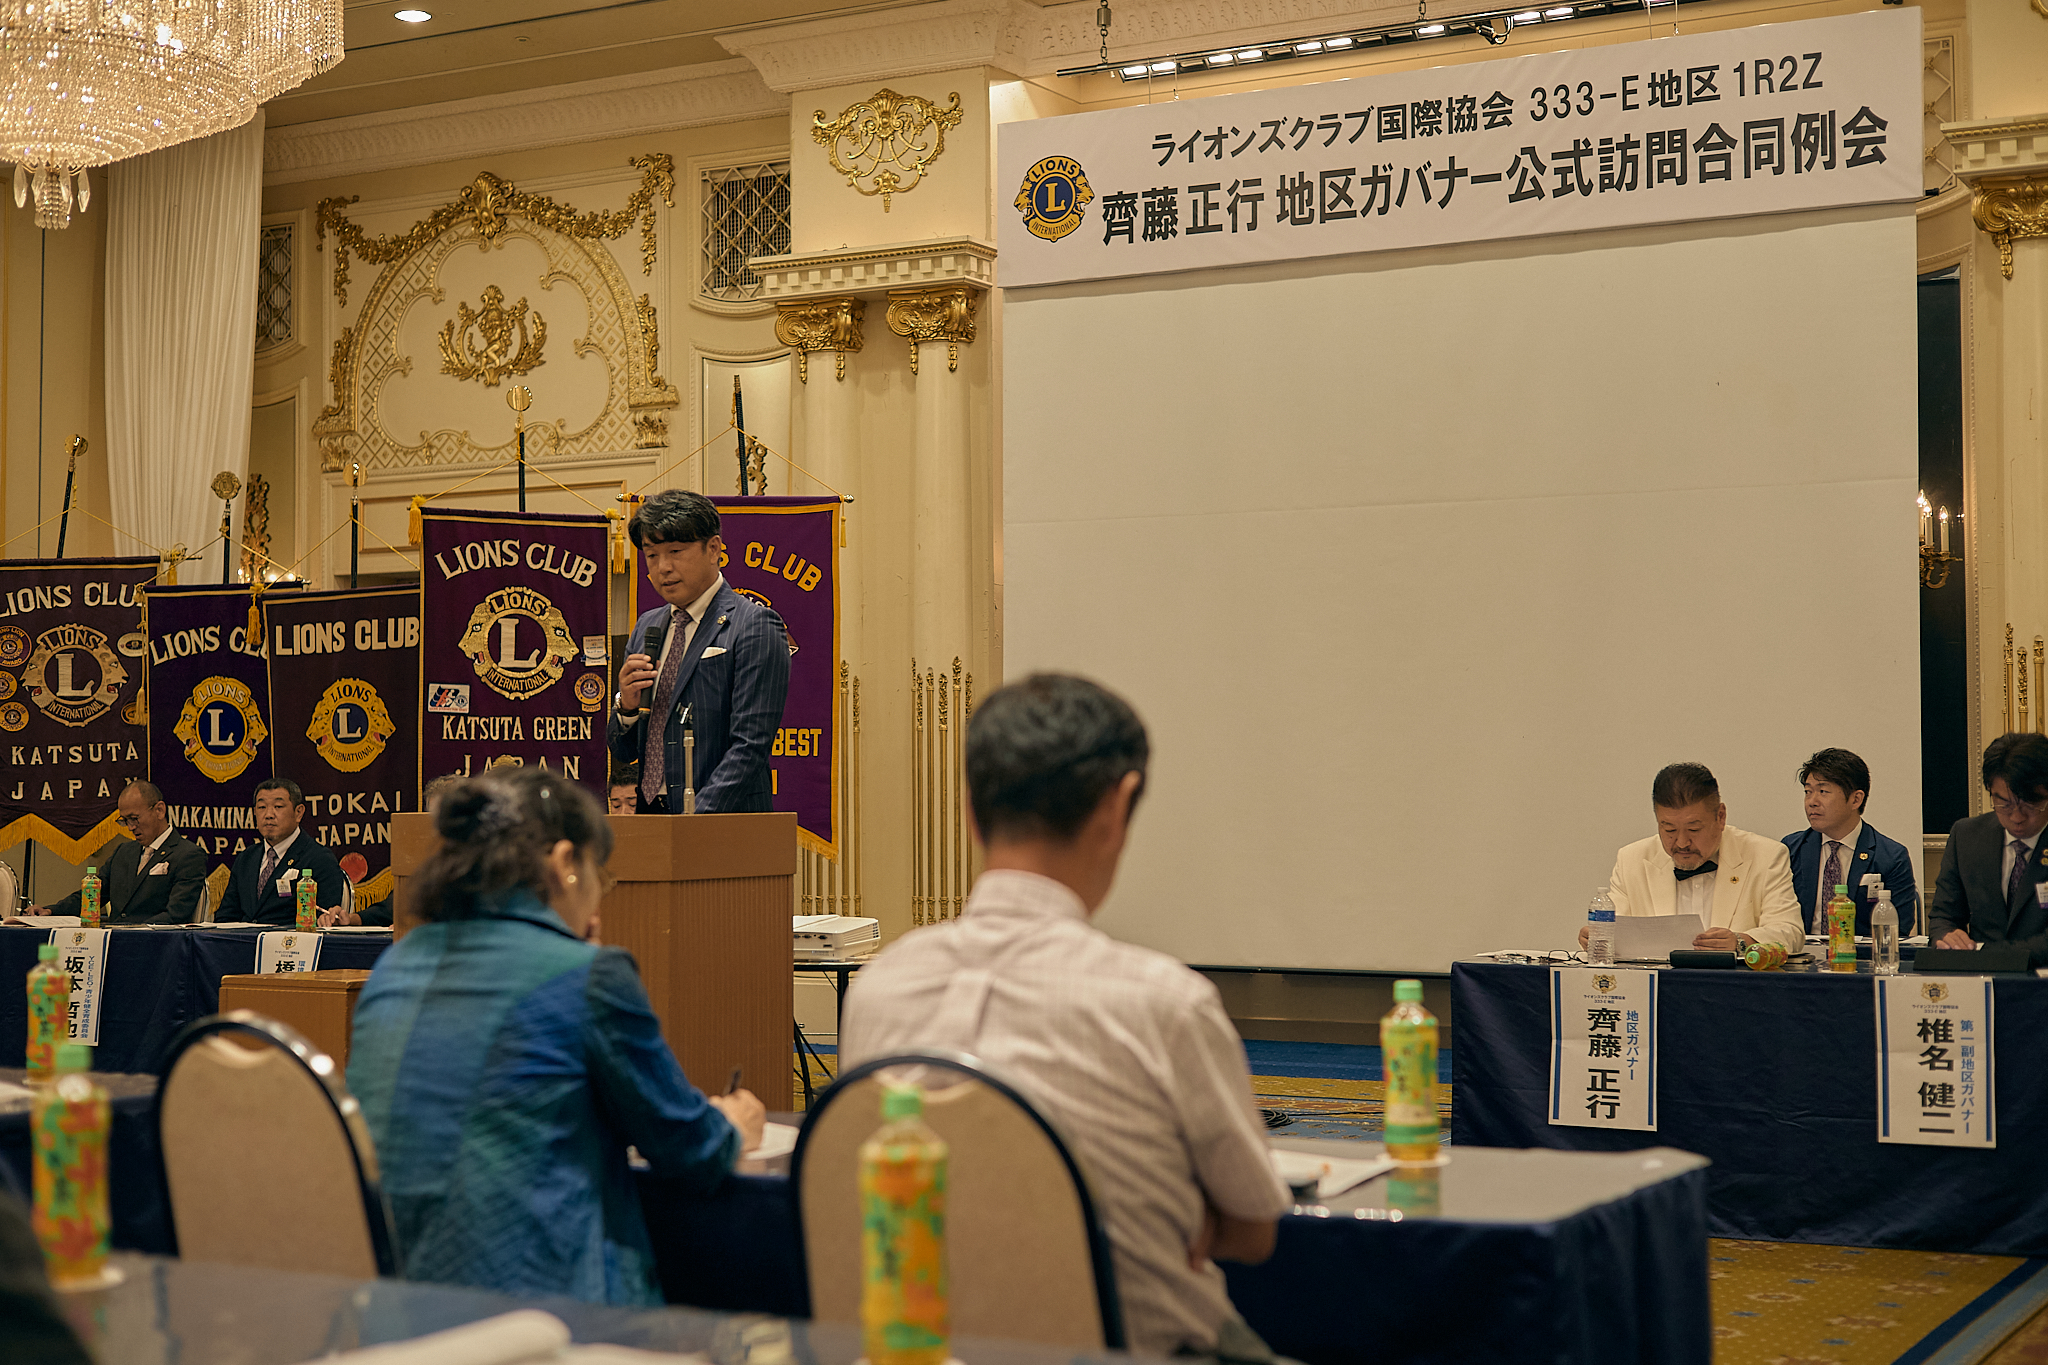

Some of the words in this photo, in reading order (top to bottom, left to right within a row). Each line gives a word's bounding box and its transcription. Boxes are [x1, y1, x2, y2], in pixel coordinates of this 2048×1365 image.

[1152, 91, 1514, 166] ライオンズクラブ国際協会
[1732, 52, 1824, 97] 1R2Z
[1031, 160, 1077, 179] LIONS
[1045, 183, 1066, 212] L
[1031, 218, 1077, 235] INTERNATIONAL
[434, 539, 520, 581] LIONS
[525, 542, 598, 587] CLUB
[744, 541, 822, 592] CLUB
[84, 582, 144, 608] CLU
[490, 593, 550, 620] LIONS
[44, 628, 100, 651] LIONS
[149, 625, 221, 666] LIONS
[276, 621, 346, 656] LIONS
[354, 616, 420, 651] CLUB
[498, 618, 541, 668] L
[55, 653, 95, 697] L
[487, 669, 549, 692] INTERNATIONAL
[198, 682, 246, 703] LIONS
[330, 684, 372, 702] LIONS
[47, 701, 104, 719] INTERNATIONAL
[207, 709, 235, 746] L
[337, 708, 361, 739] L
[442, 715, 525, 741] KATSUTA
[533, 716, 593, 741] GREEN
[11, 741, 139, 765] KATSUTA
[327, 745, 376, 763] INTERNATIONAL
[11, 777, 138, 800] JAPA
[305, 790, 401, 816] TOKAI
[167, 805, 258, 829] NAKAMINA
[315, 822, 391, 847] JAPAN
[1626, 1009, 1639, 1081] 地区ガバナー
[1960, 1020, 1975, 1134] 第一副地区ガバナー
